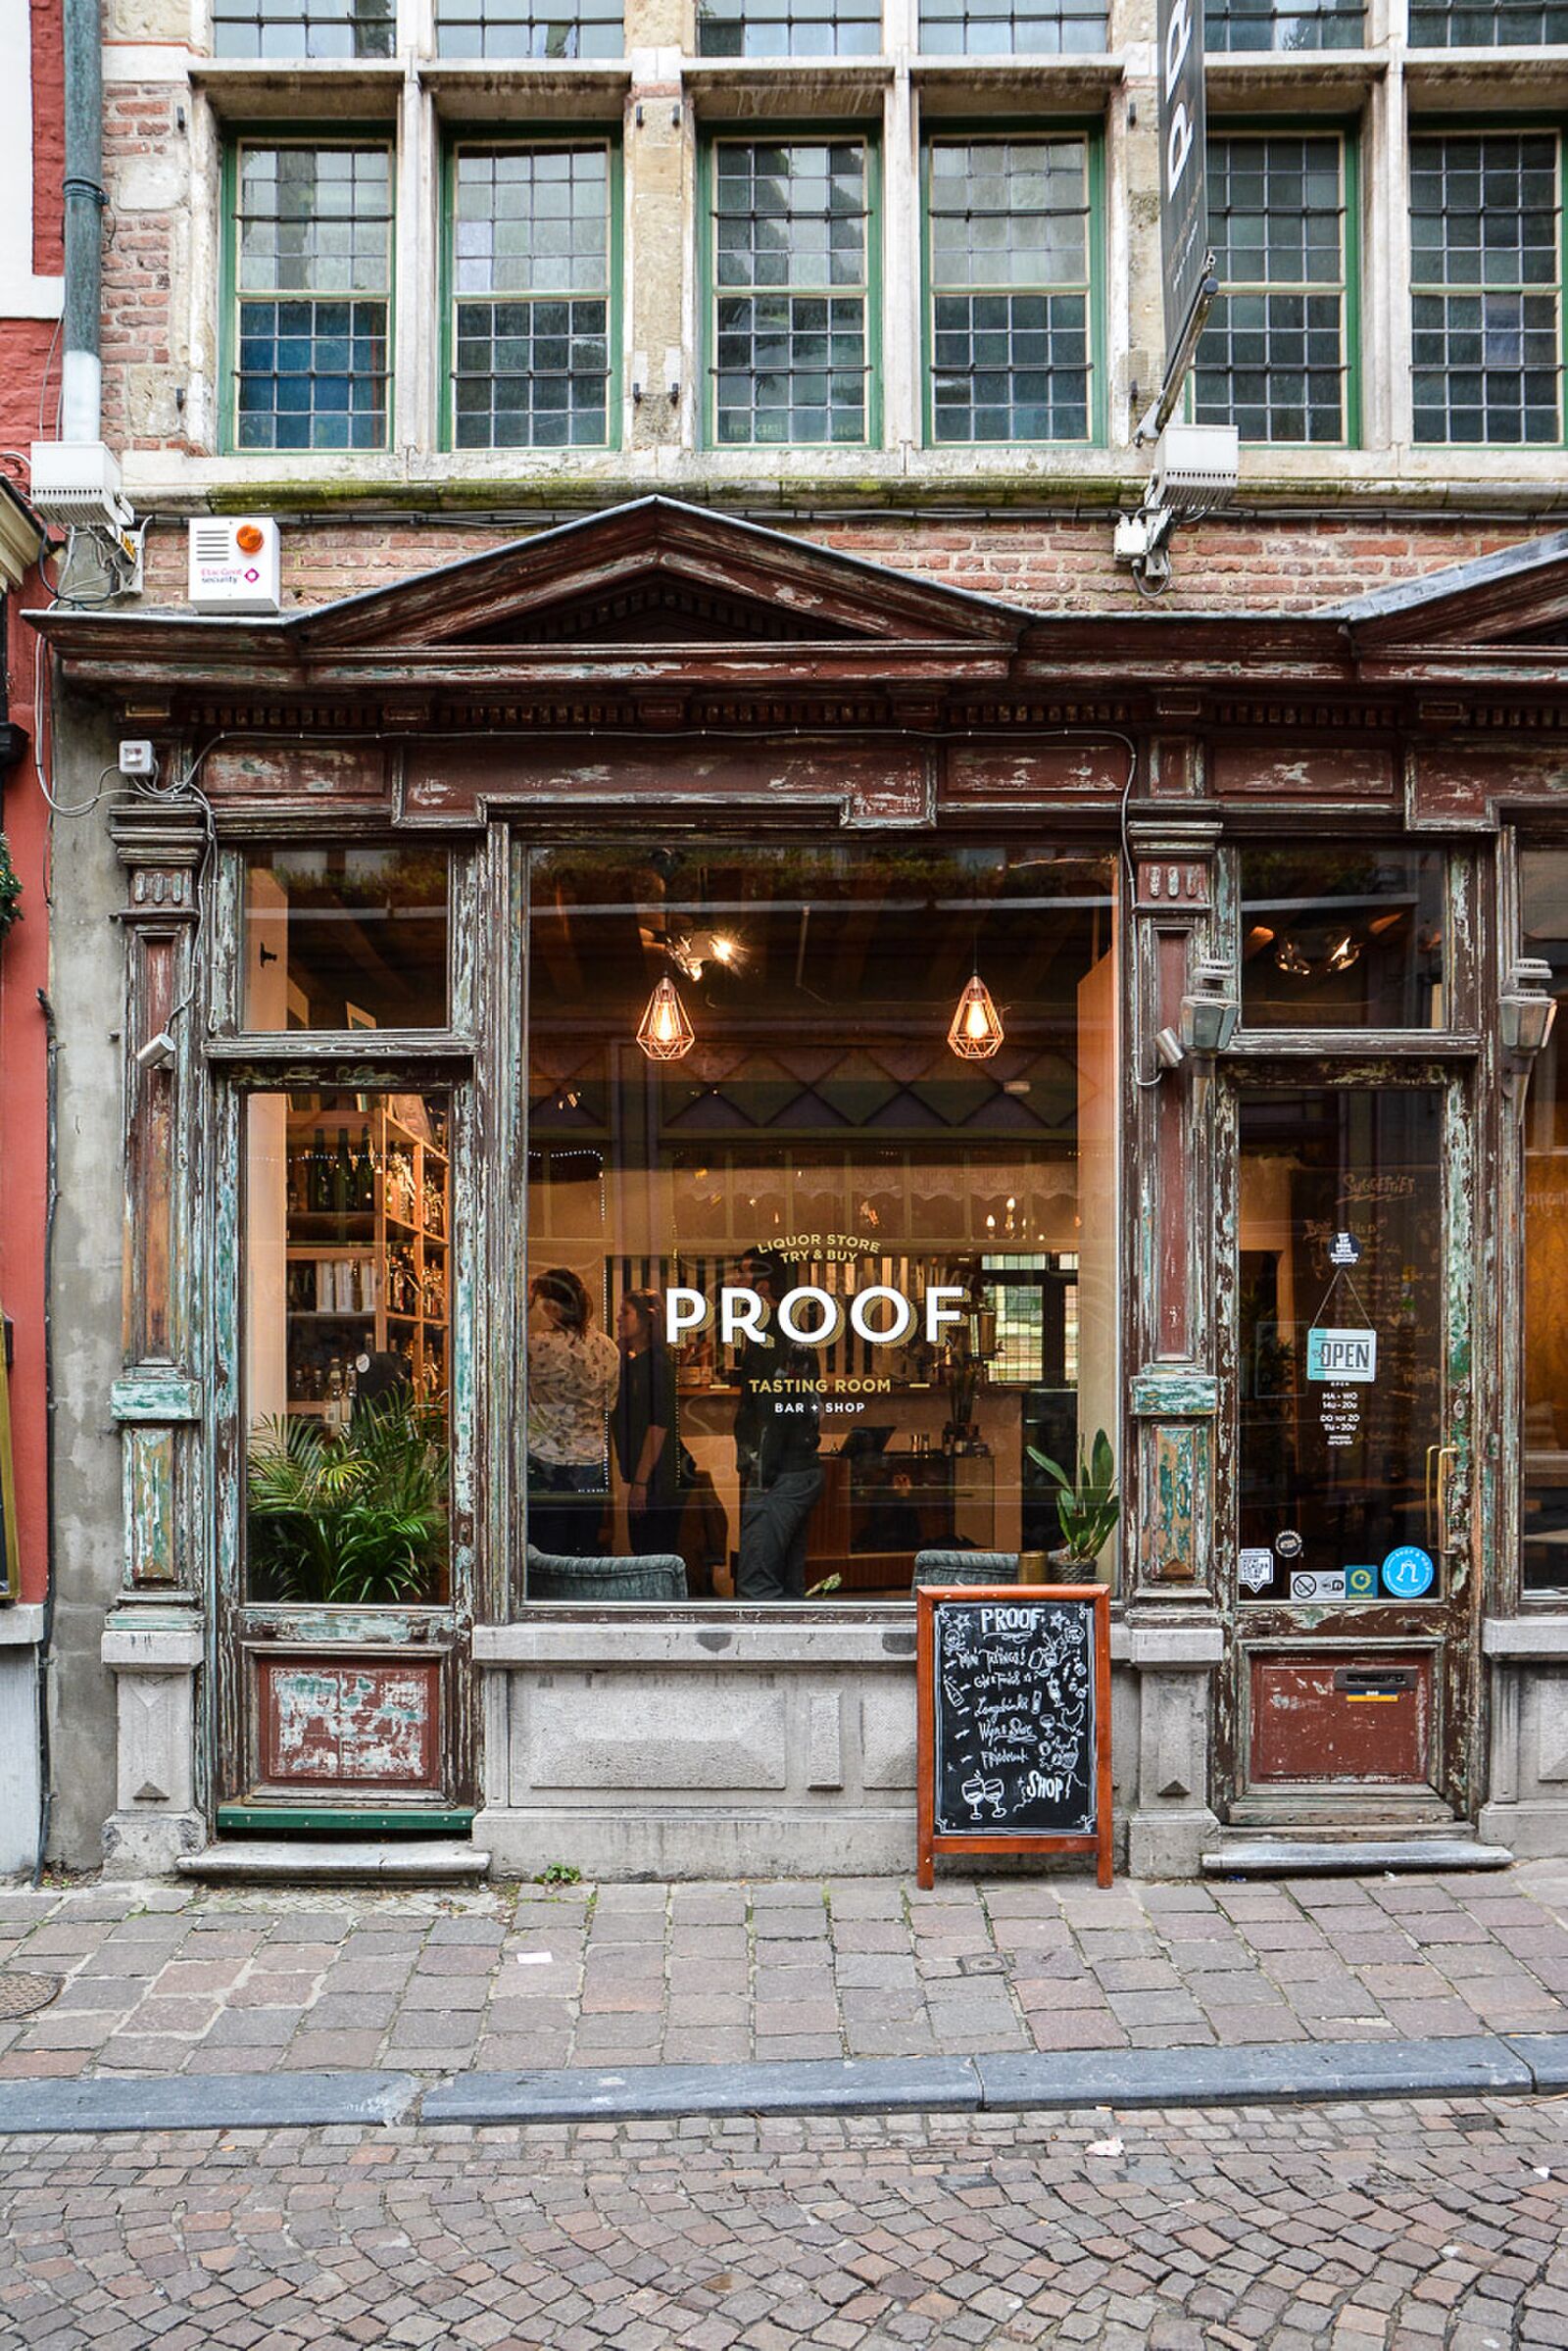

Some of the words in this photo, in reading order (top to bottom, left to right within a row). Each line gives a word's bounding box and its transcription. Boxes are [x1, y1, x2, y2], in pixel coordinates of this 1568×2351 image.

[757, 1234, 821, 1254] LIQUOR
[827, 1234, 881, 1254] STORE
[779, 1249, 809, 1264] TRY
[812, 1249, 822, 1260] &
[826, 1249, 858, 1263] BUY
[665, 1286, 970, 1347] PROOF
[1320, 1343, 1370, 1368] OPEN
[749, 1379, 828, 1394] TASTING
[834, 1379, 892, 1394] ROOM
[775, 1402, 805, 1413] BAR
[810, 1403, 819, 1412] +
[825, 1402, 866, 1413] SHOP
[981, 1607, 1045, 1634] PROOF
